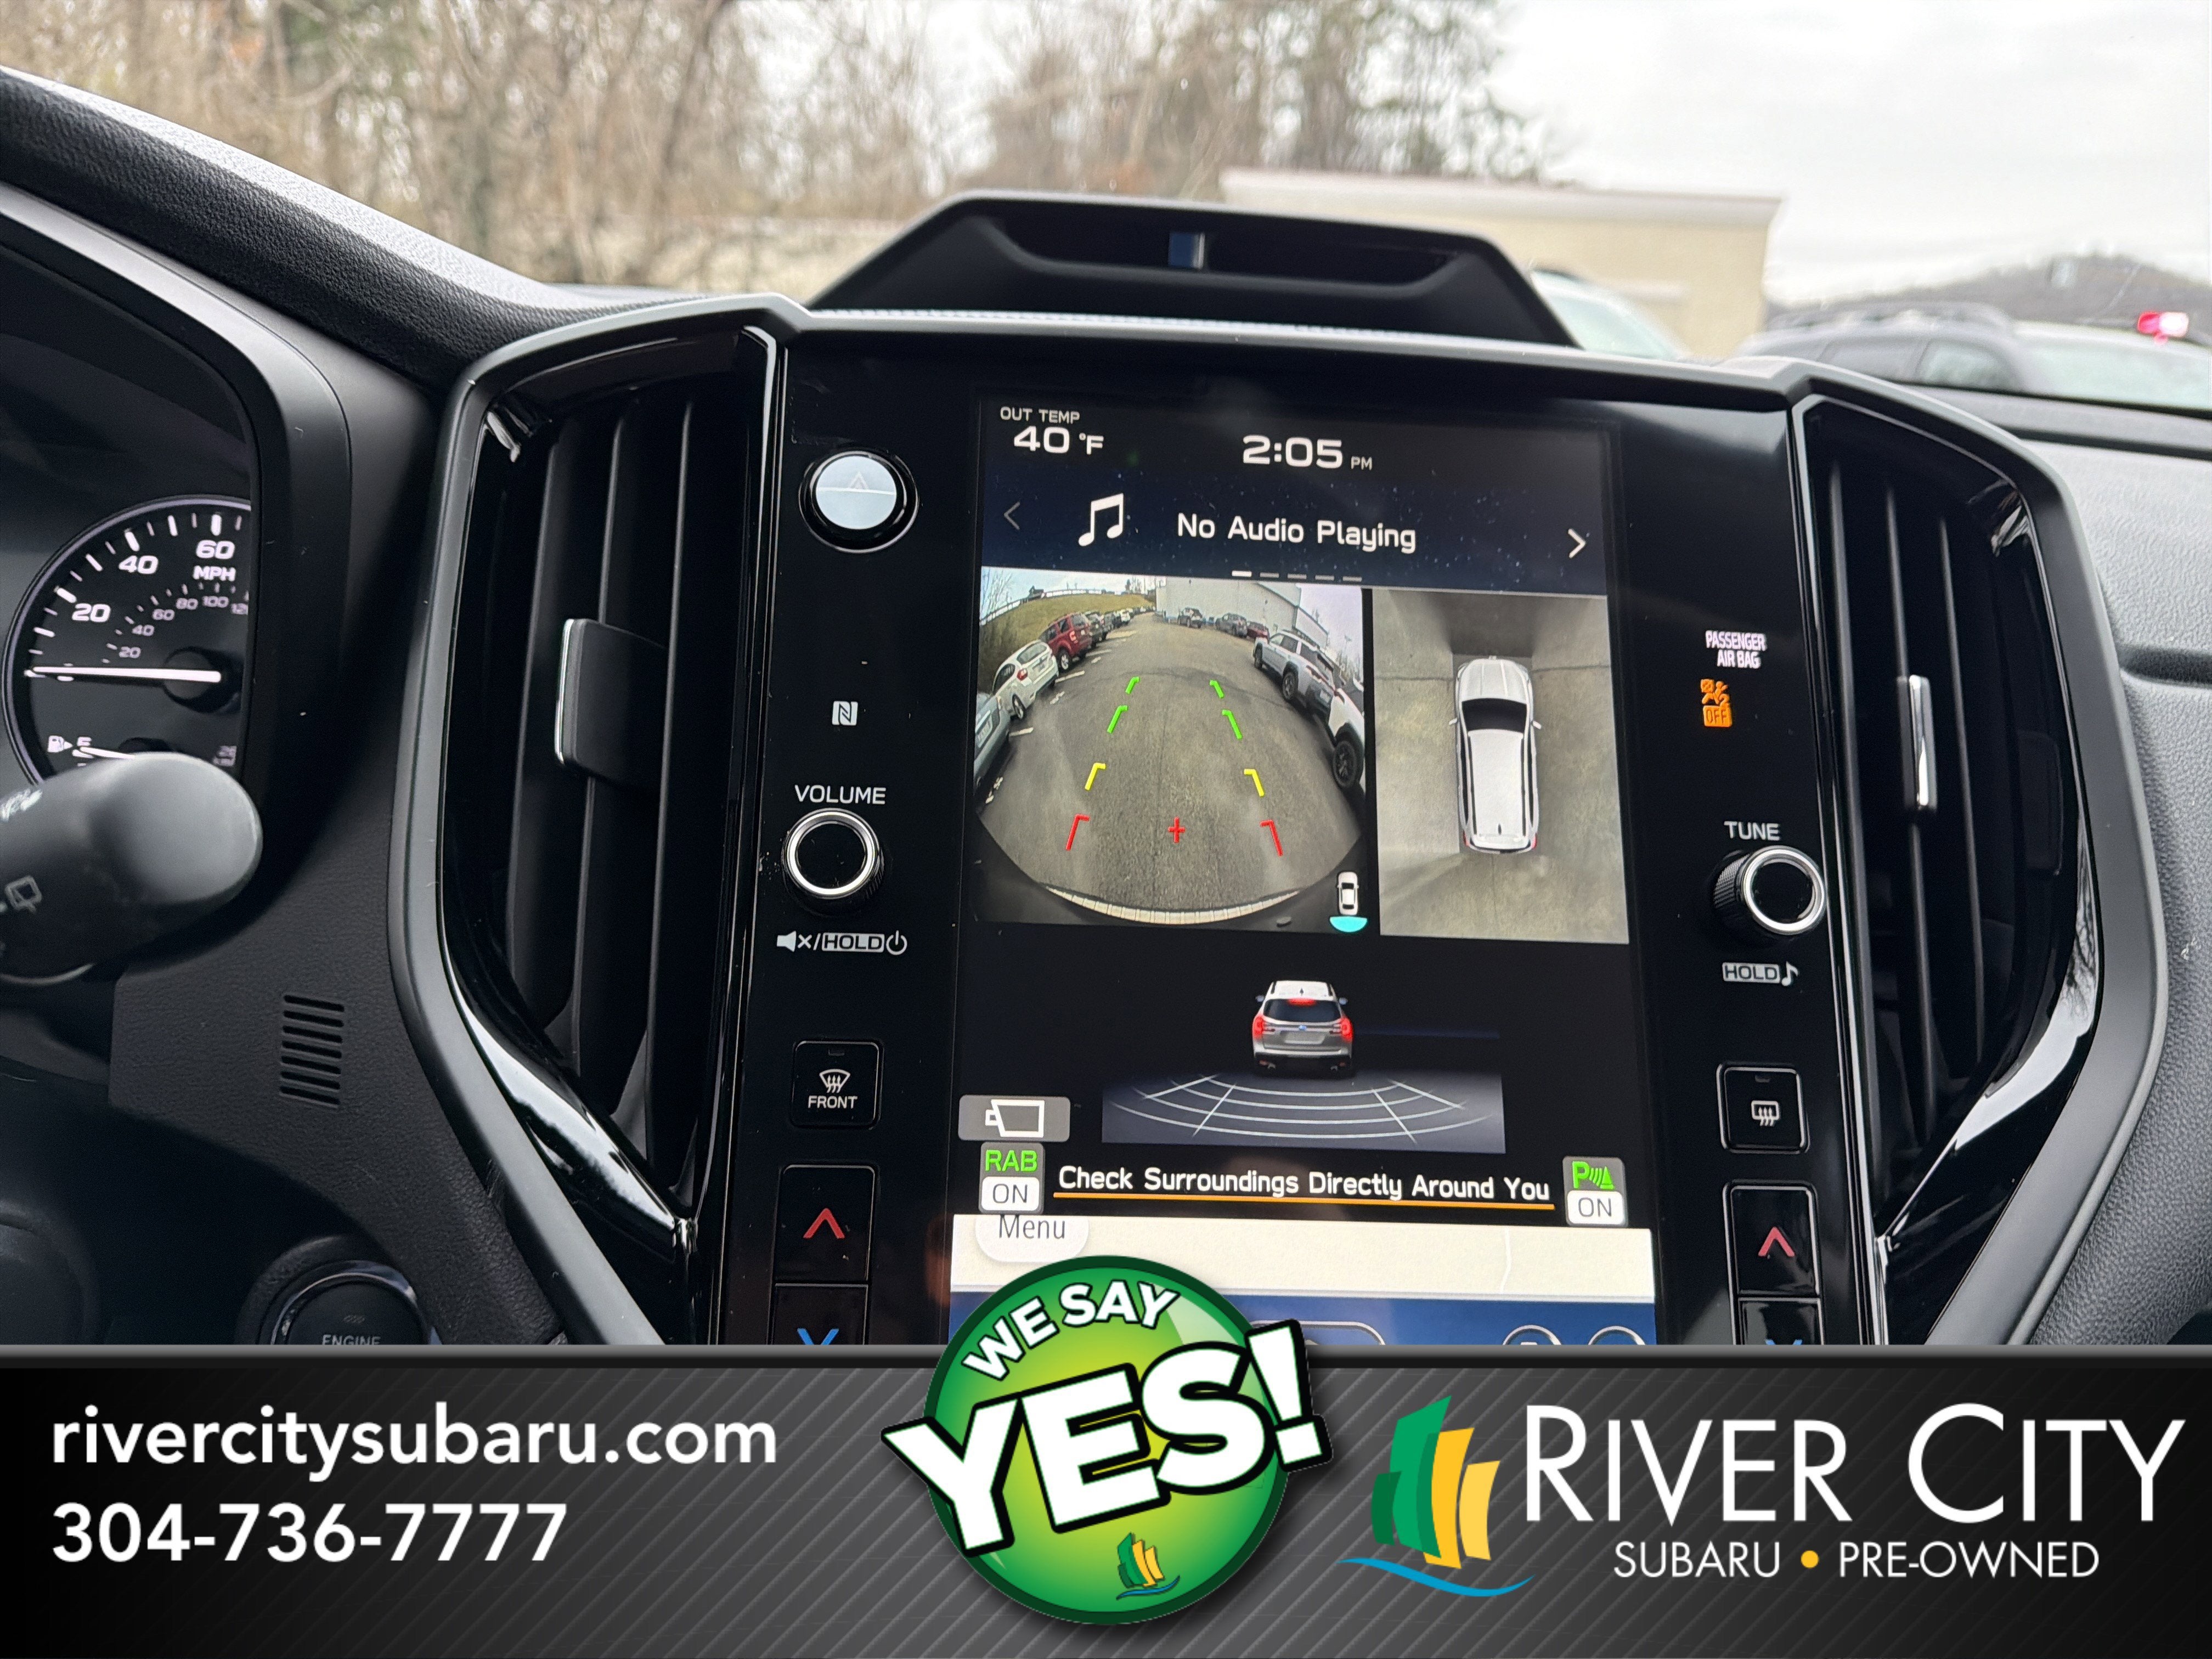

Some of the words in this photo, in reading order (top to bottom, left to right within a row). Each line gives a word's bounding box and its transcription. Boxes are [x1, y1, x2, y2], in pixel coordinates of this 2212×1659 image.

[1000, 407, 1032, 421] OUT
[1039, 409, 1080, 424] TEMP
[1014, 426, 1070, 454] 40
[1243, 435, 1343, 469] 2:05
[1351, 456, 1372, 470] PM
[1178, 512, 1215, 539] No
[1227, 516, 1304, 543] Audio
[1317, 520, 1416, 554] Playing
[196, 540, 235, 560] 60
[119, 555, 159, 574] 40
[193, 565, 236, 582] MPH
[176, 597, 199, 610] 80
[202, 596, 229, 608] 100
[71, 603, 110, 623] 20
[152, 608, 175, 621] 60
[132, 624, 155, 636] 40
[1706, 630, 1767, 651] PASSENGER
[119, 646, 141, 659] 20
[1717, 650, 1735, 667] AIR
[1737, 651, 1760, 669] BAG
[1706, 709, 1727, 724] OFF
[794, 785, 886, 805] VOLUME
[1724, 821, 1780, 841] TUNE
[826, 936, 881, 950] HOLD
[1725, 964, 1778, 981] HOLD
[808, 1095, 858, 1109] FRONT
[985, 1150, 1038, 1171] RAB
[1059, 1165, 1133, 1189] Check
[1144, 1167, 1299, 1197] Surroundings
[1308, 1172, 1402, 1200] Directly
[1412, 1175, 1494, 1199] Around
[1504, 1177, 1550, 1200] You
[993, 1184, 1028, 1204] ON
[1578, 1197, 1612, 1217] ON
[999, 1215, 1065, 1239] Menu
[321, 1334, 380, 1345] ENGINE
